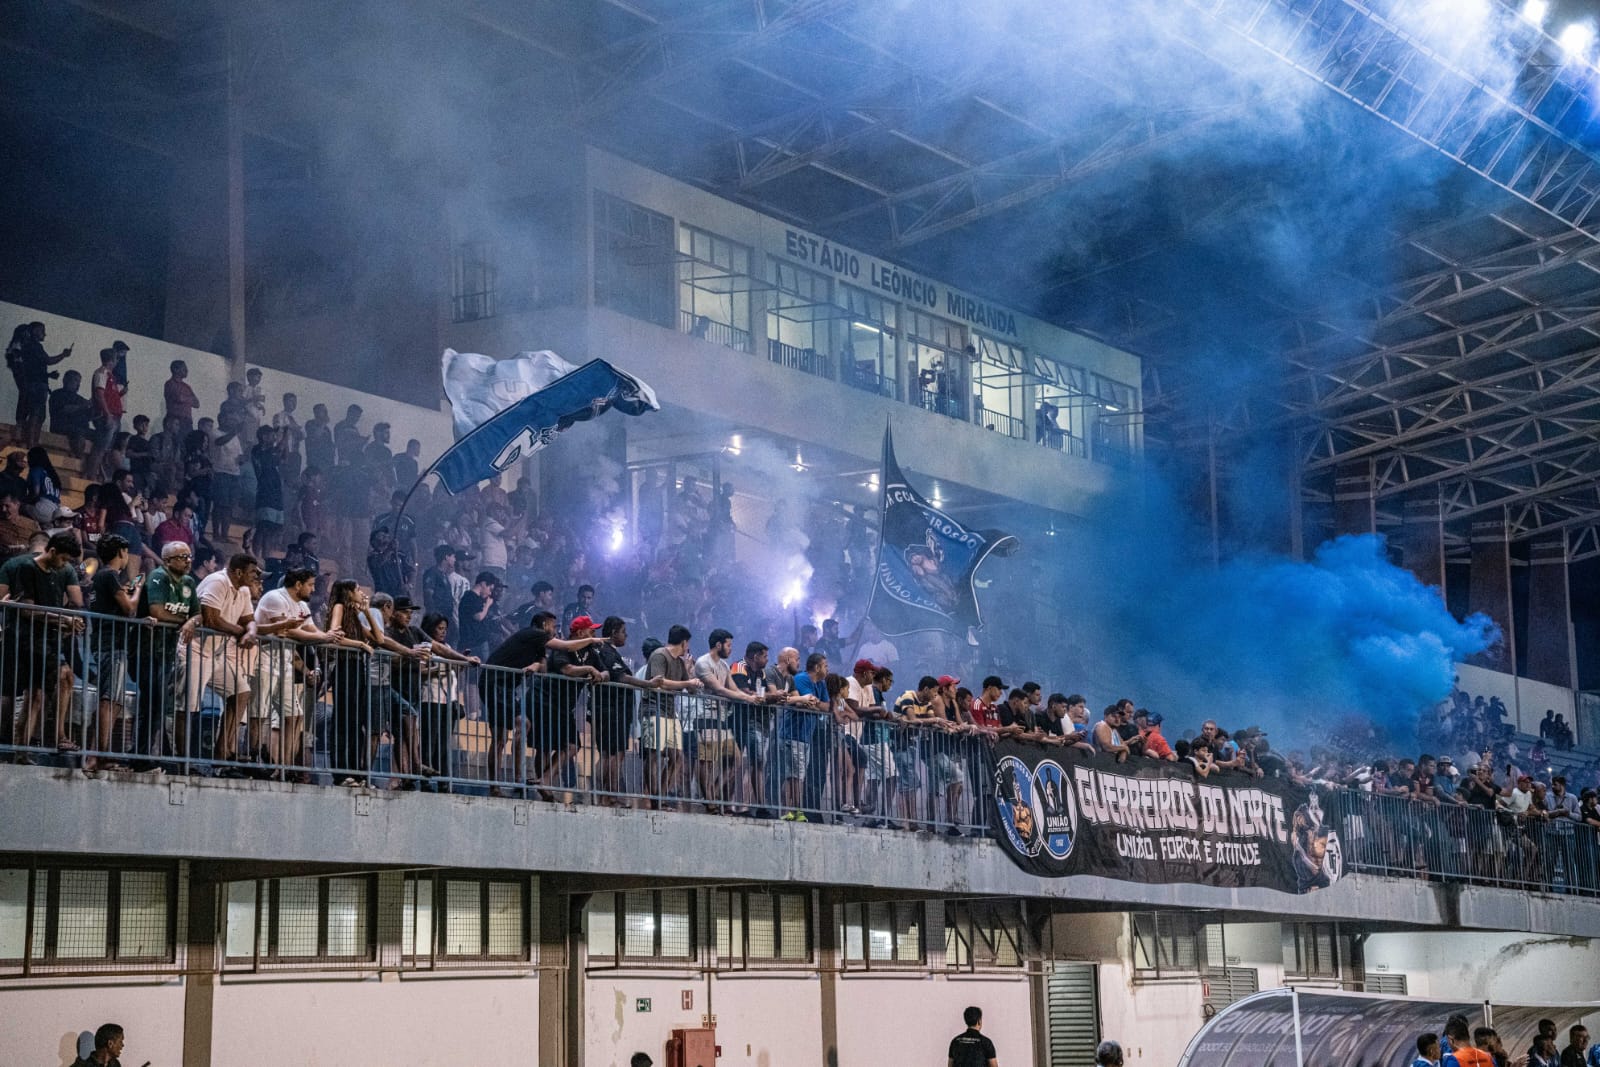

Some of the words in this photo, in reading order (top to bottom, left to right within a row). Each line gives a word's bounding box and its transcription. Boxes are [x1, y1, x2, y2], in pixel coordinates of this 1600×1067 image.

[786, 230, 860, 279] ESTÁDIO
[947, 291, 1017, 337] MIRANDA
[1047, 814, 1069, 828] UNIÃO
[1074, 765, 1199, 831] GUERREIROS
[1199, 783, 1229, 835] DO
[1227, 787, 1288, 843] NORTE
[1159, 835, 1201, 864] FORÇA
[1203, 840, 1213, 863] E
[1216, 841, 1261, 866] ATITUDE
